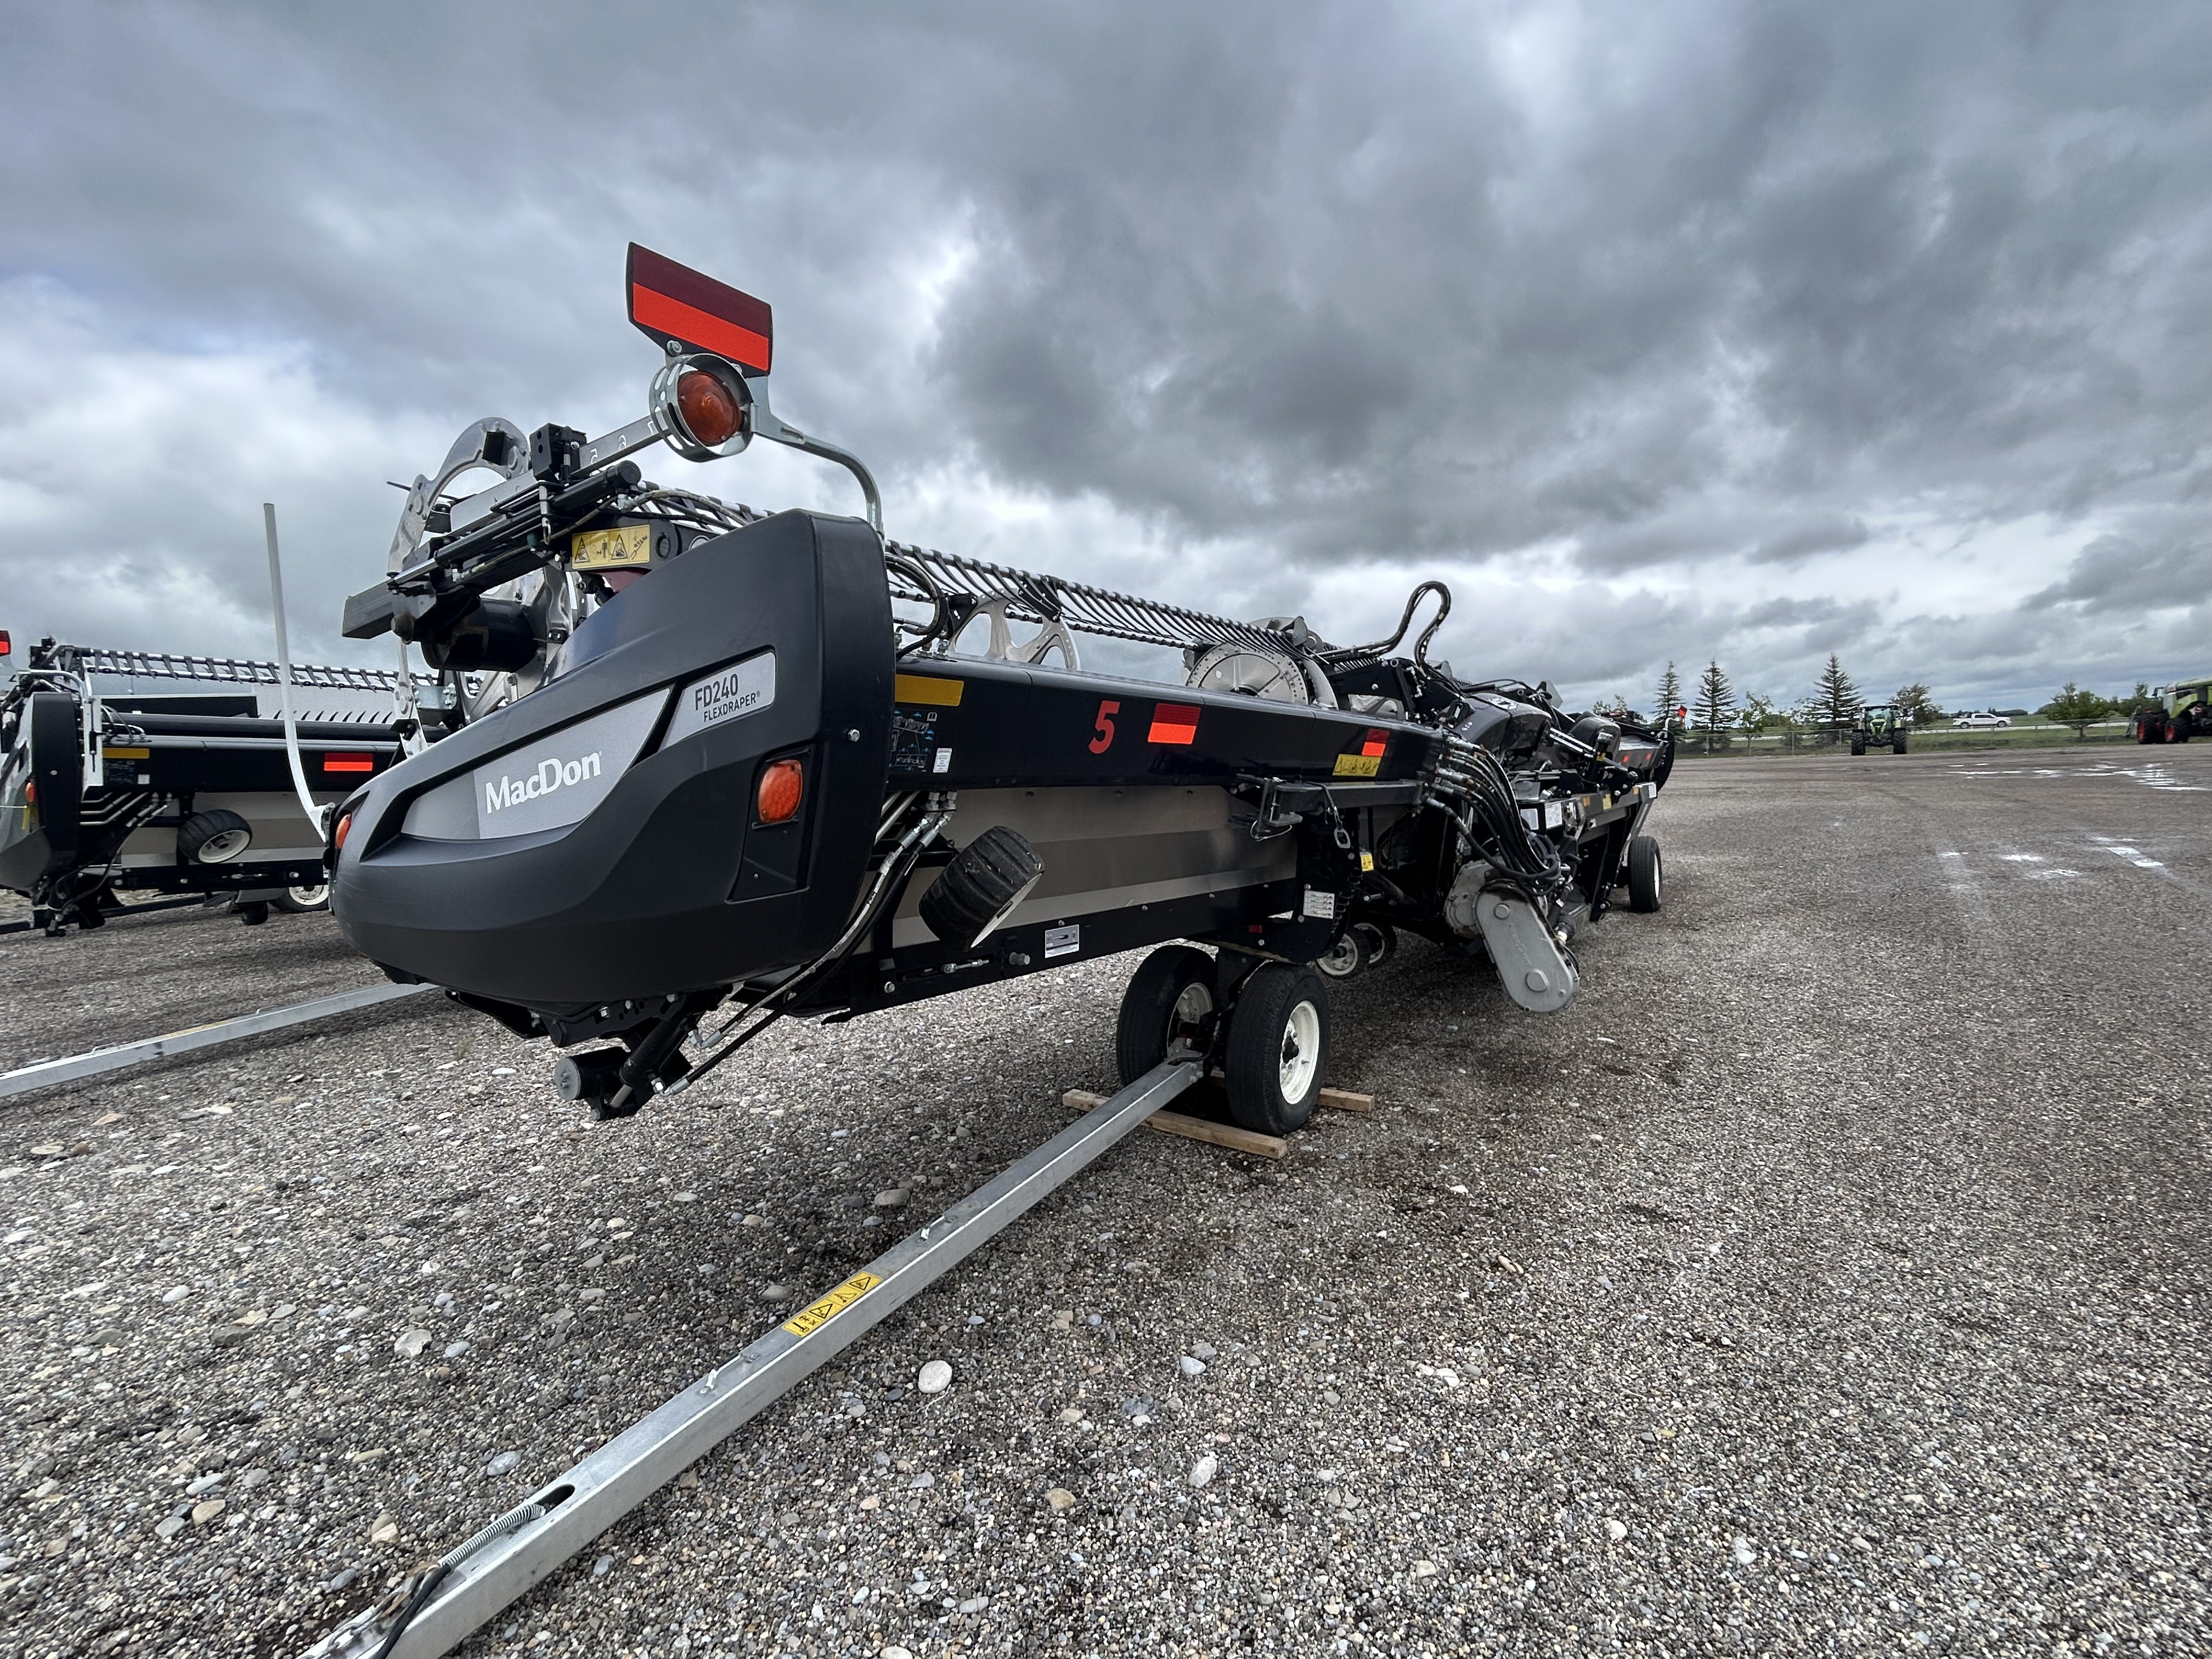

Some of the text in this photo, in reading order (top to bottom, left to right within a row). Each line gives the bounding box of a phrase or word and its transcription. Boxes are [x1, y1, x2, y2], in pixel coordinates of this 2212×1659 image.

[695, 674, 738, 710] FD240
[1089, 701, 1120, 754] 5
[486, 752, 602, 814] MacDon
